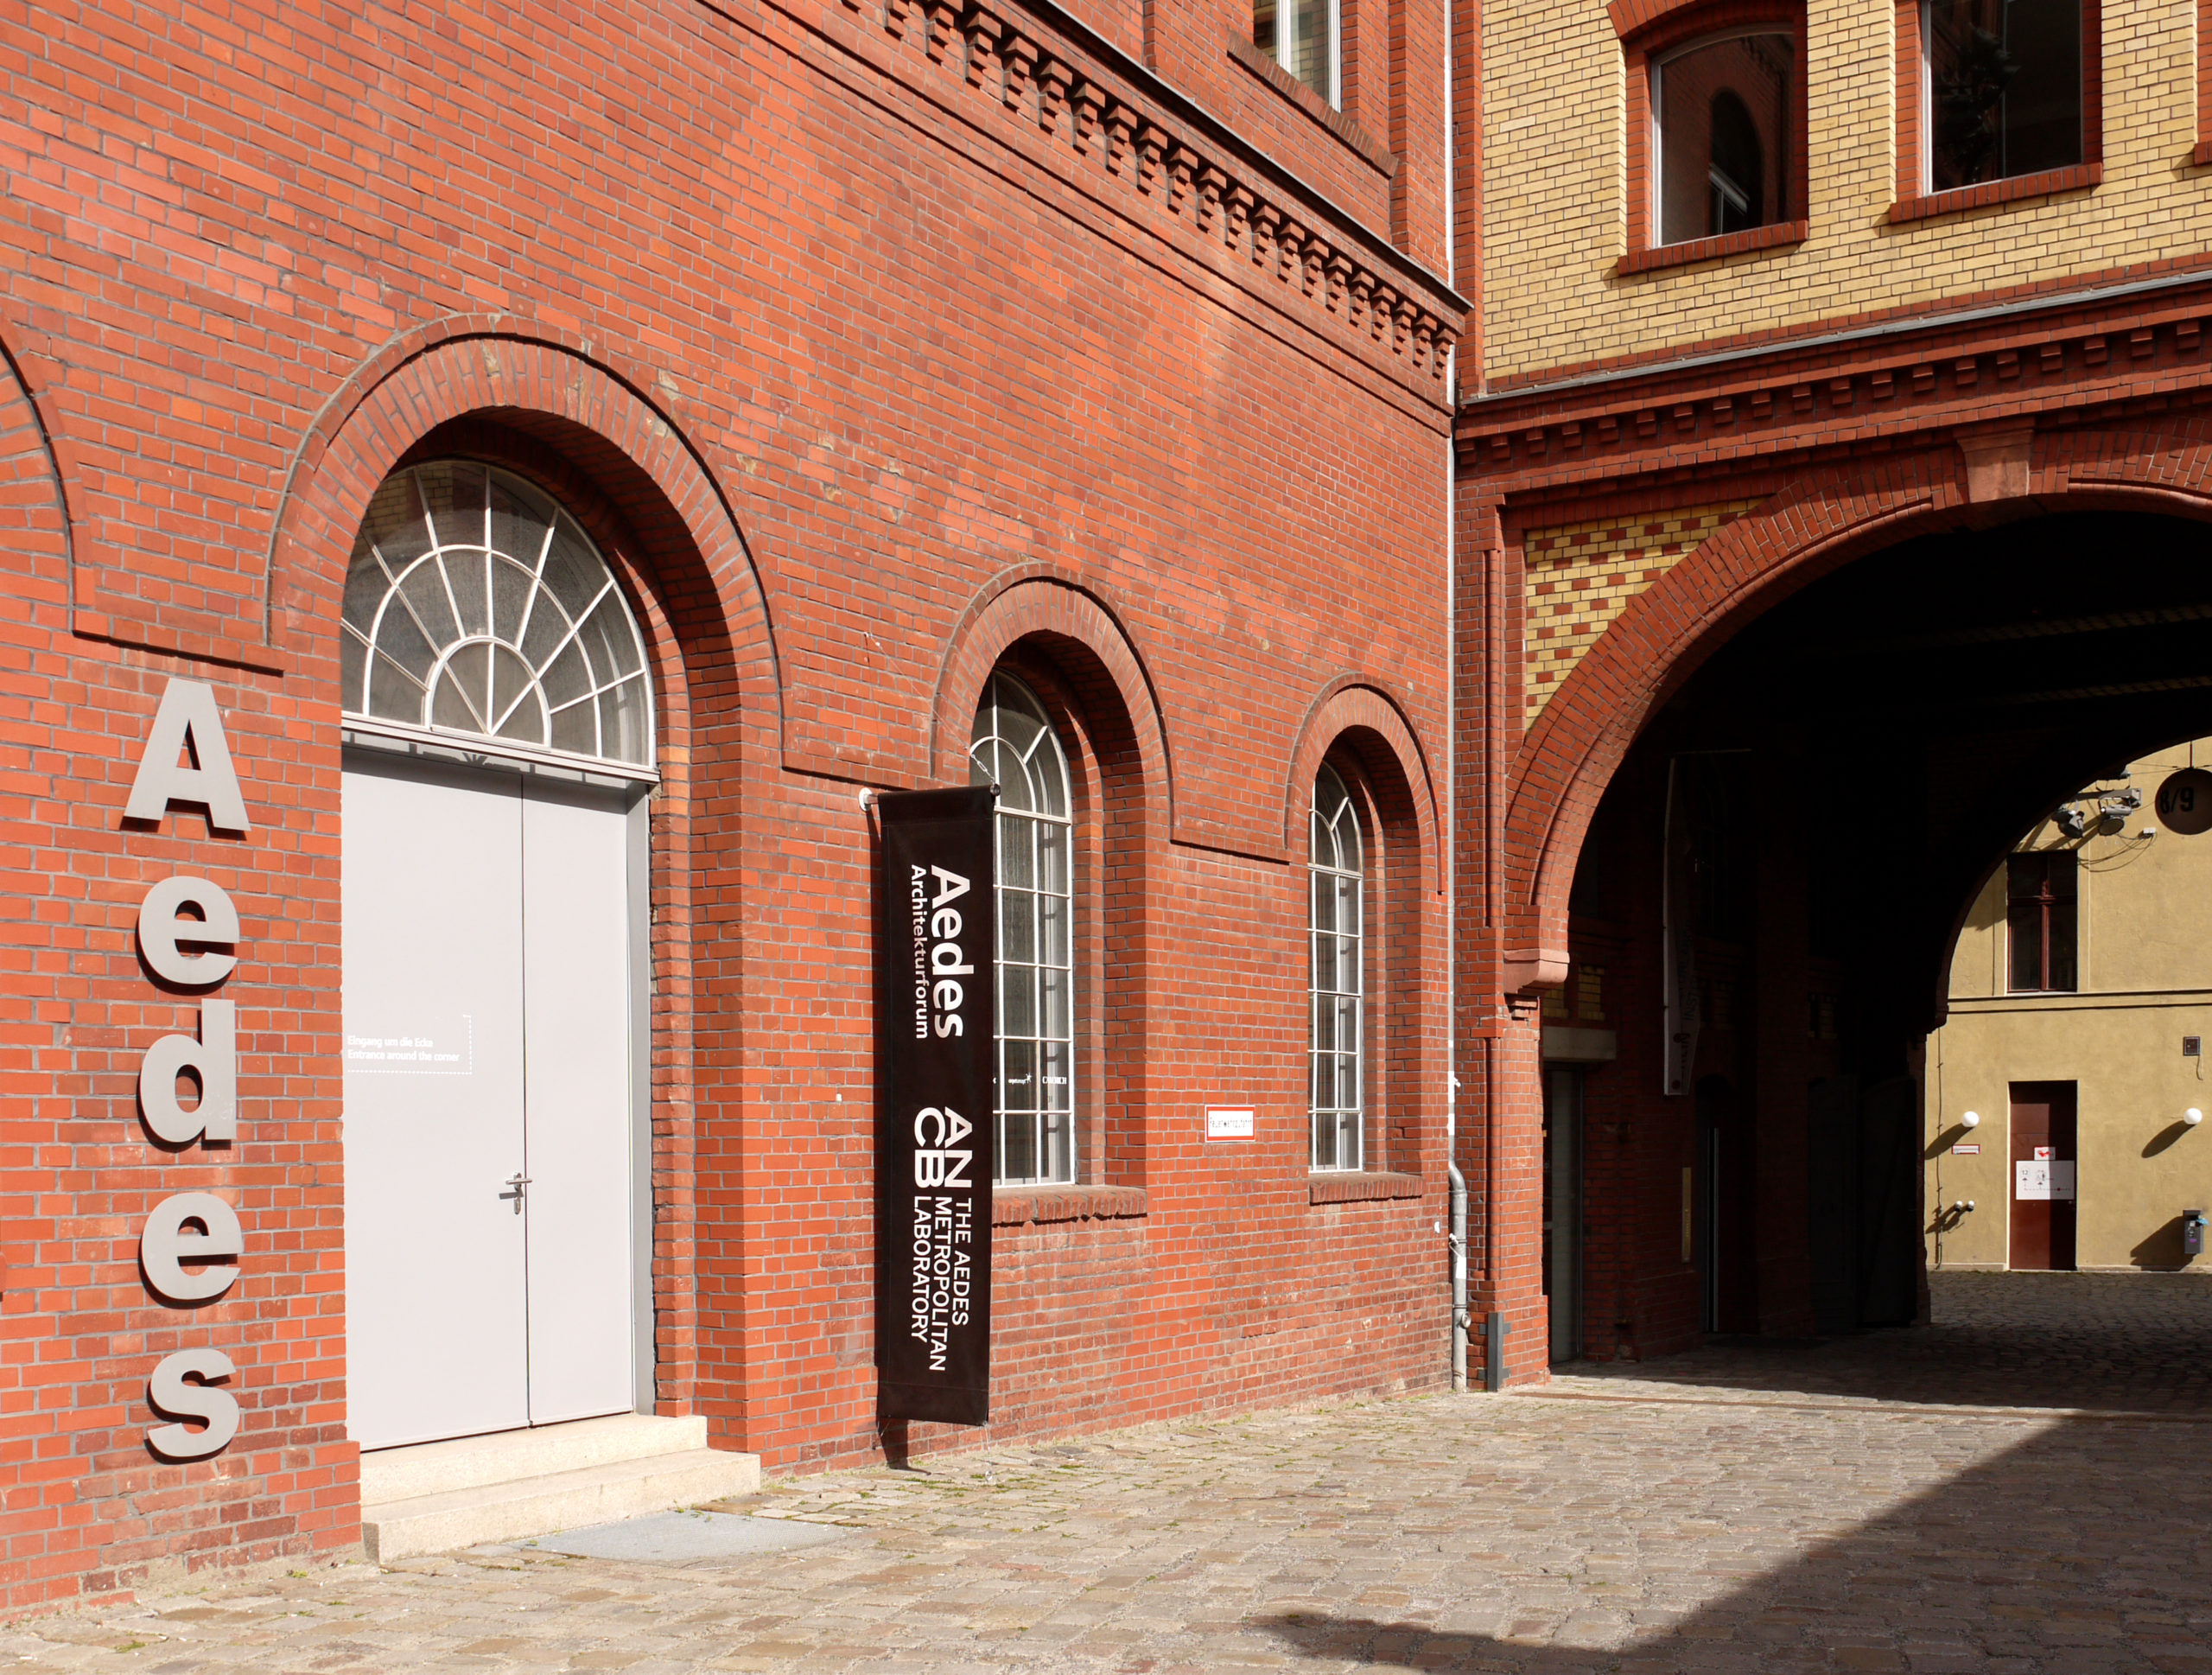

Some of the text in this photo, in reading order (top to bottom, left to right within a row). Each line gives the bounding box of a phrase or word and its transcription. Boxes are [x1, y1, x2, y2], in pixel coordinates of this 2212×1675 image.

[2160, 787, 2195, 814] 8/9
[912, 864, 929, 1039] Architekturforum
[931, 864, 974, 1038] Aedes
[123, 677, 251, 1458] Aedes
[347, 1035, 434, 1048] Eingang um die Ecke
[347, 1049, 460, 1062] Entrance around the corner
[912, 1195, 932, 1343] LABORATORY
[929, 1196, 952, 1371] METROPOLITAN
[951, 1197, 972, 1327] THE AEDES
